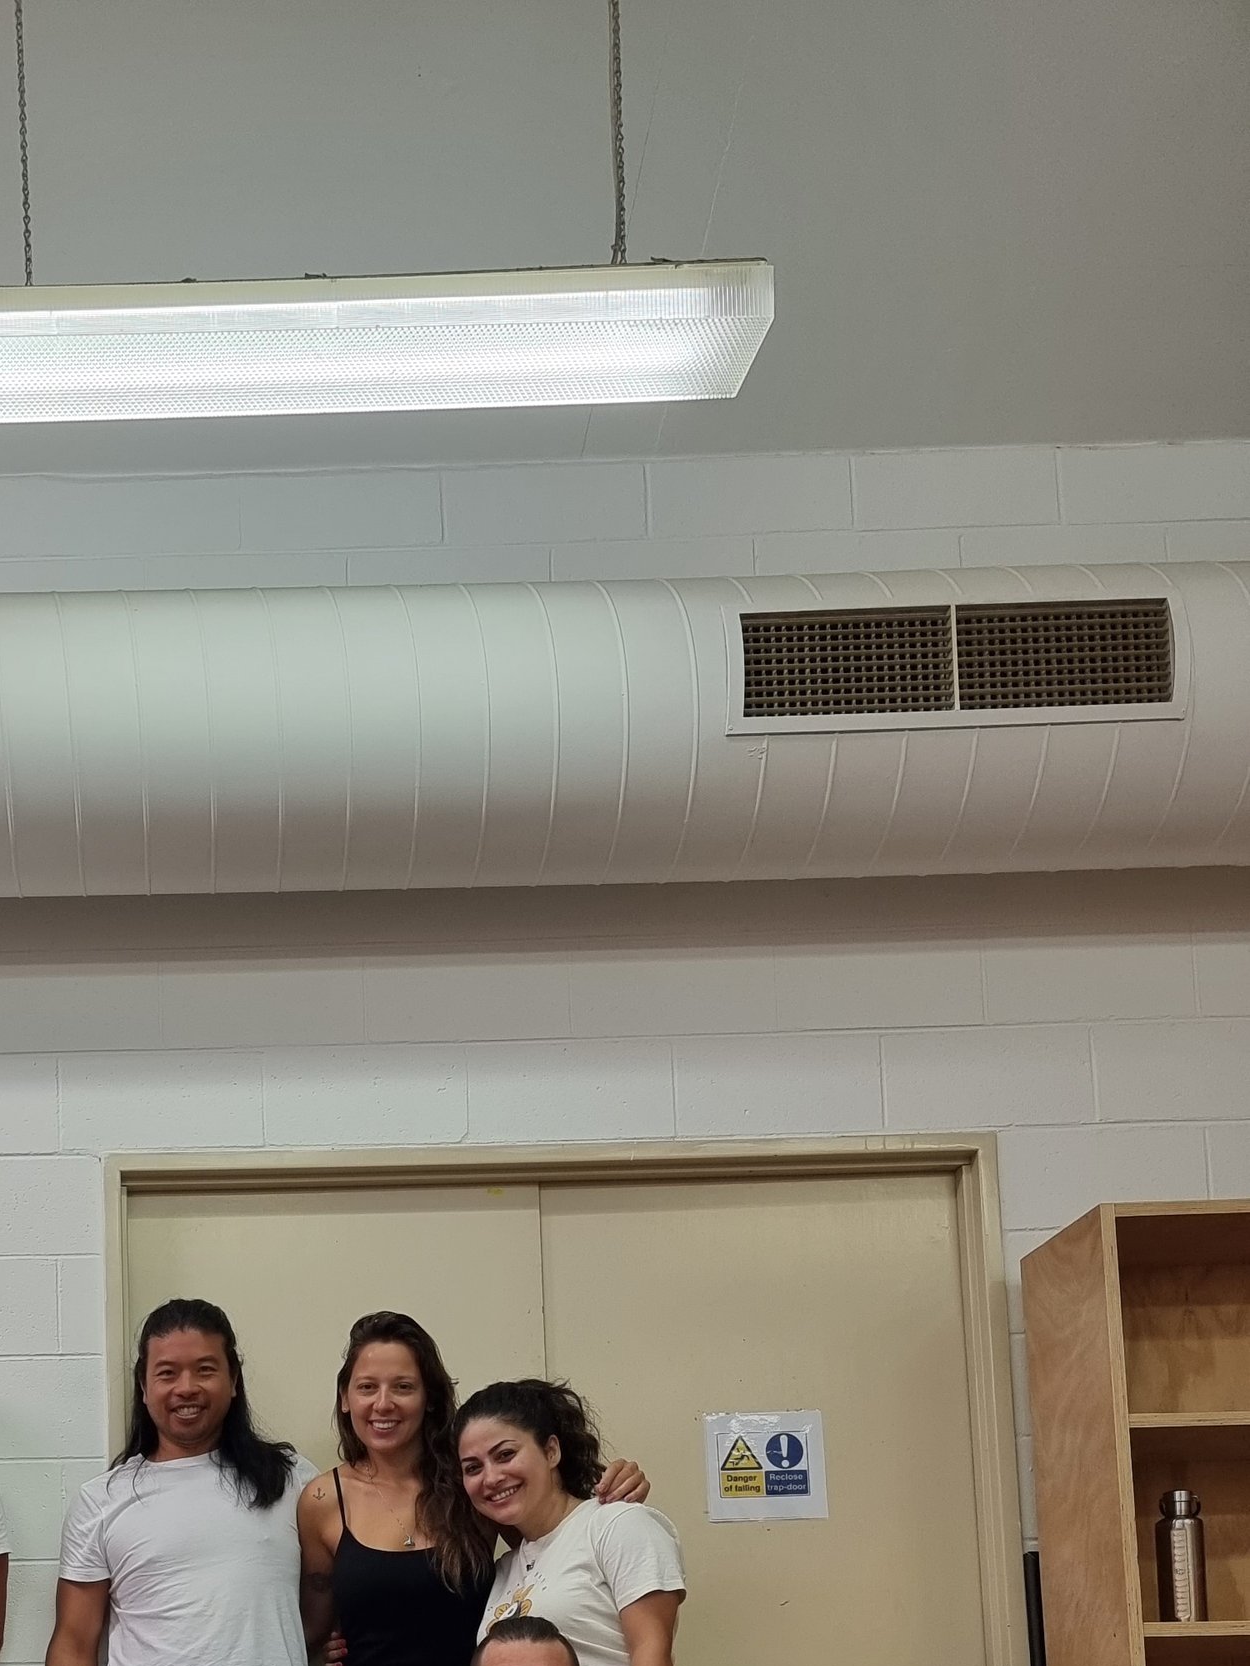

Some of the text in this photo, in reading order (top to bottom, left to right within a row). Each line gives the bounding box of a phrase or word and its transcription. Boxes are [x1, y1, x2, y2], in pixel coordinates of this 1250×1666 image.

[726, 1474, 757, 1483] Danger
[735, 1485, 761, 1493] falling
[767, 1483, 806, 1492] trap-door
